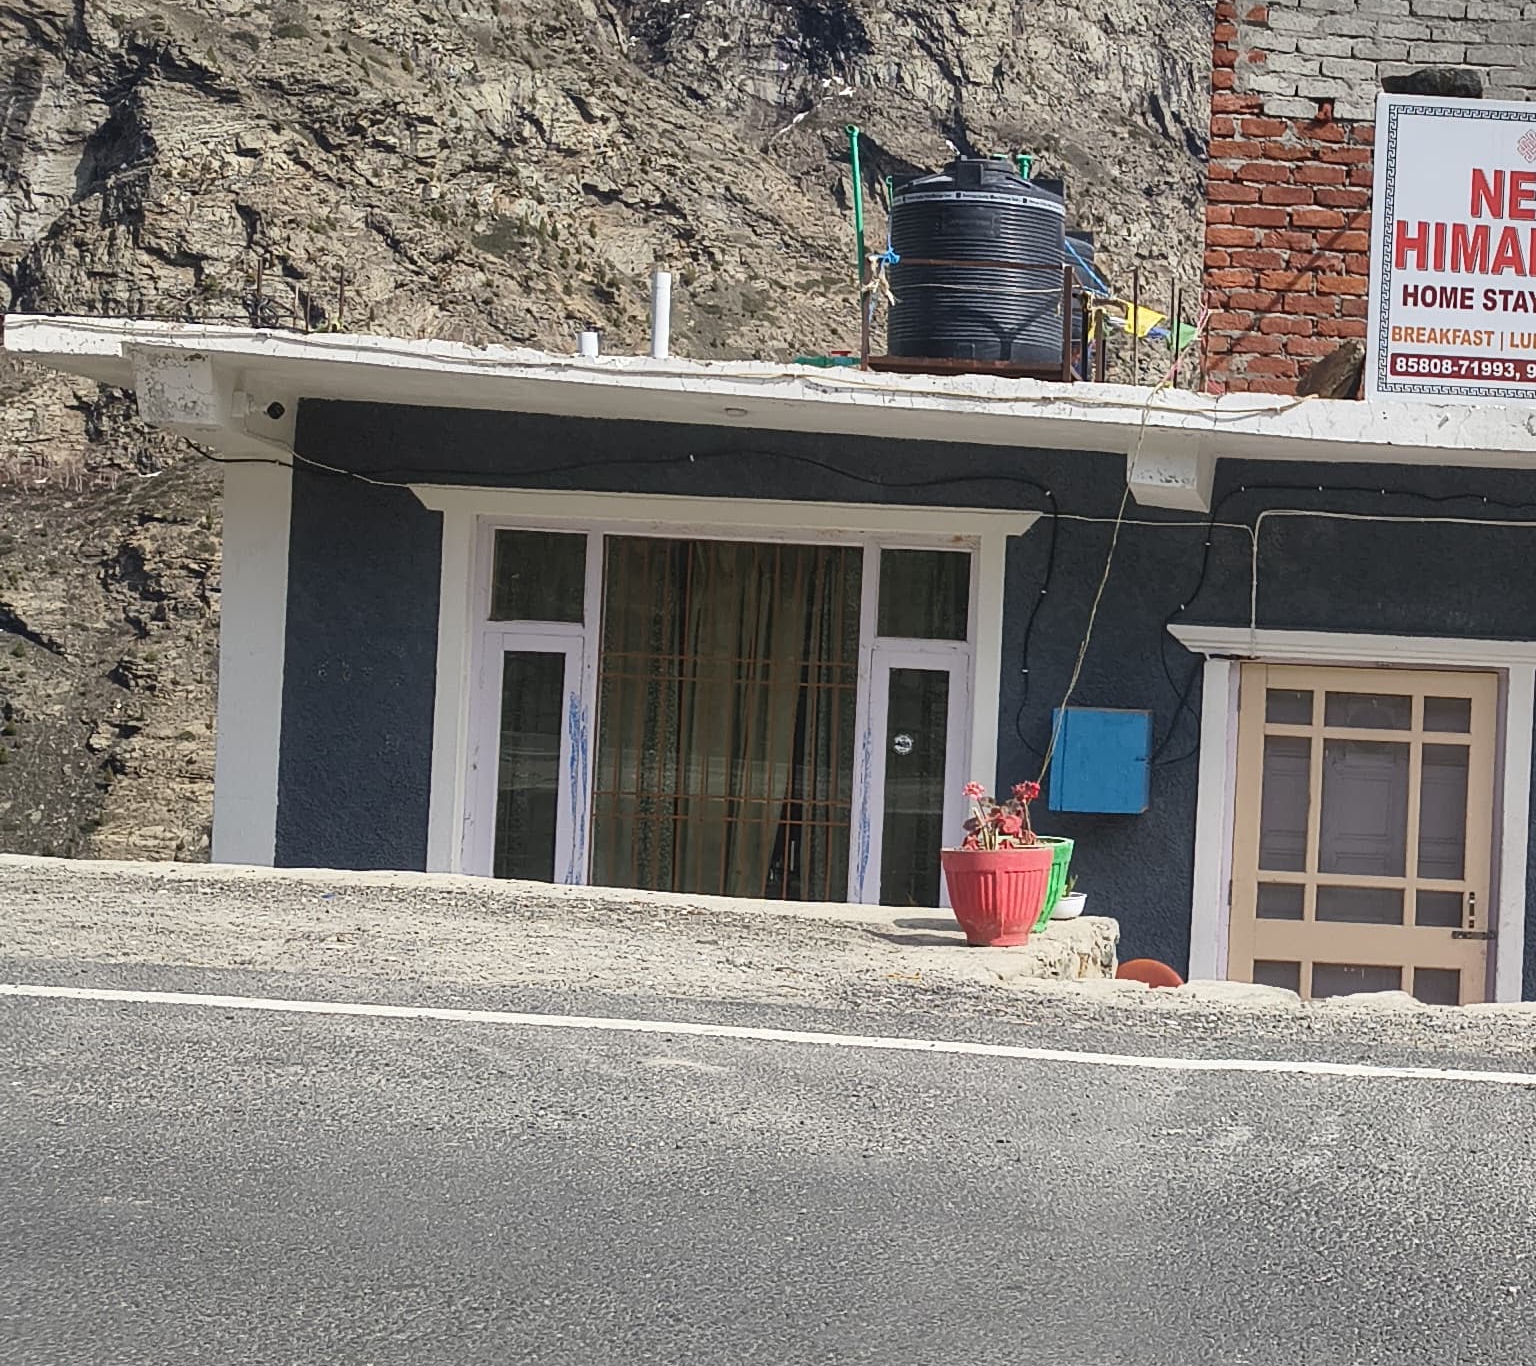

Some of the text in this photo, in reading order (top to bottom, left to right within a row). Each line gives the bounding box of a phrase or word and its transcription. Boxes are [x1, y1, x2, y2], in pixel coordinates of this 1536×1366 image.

[1402, 284, 1474, 310] HOME
[1391, 325, 1495, 347] BREAKFAST
[1395, 356, 1520, 381] 85808-71993,
